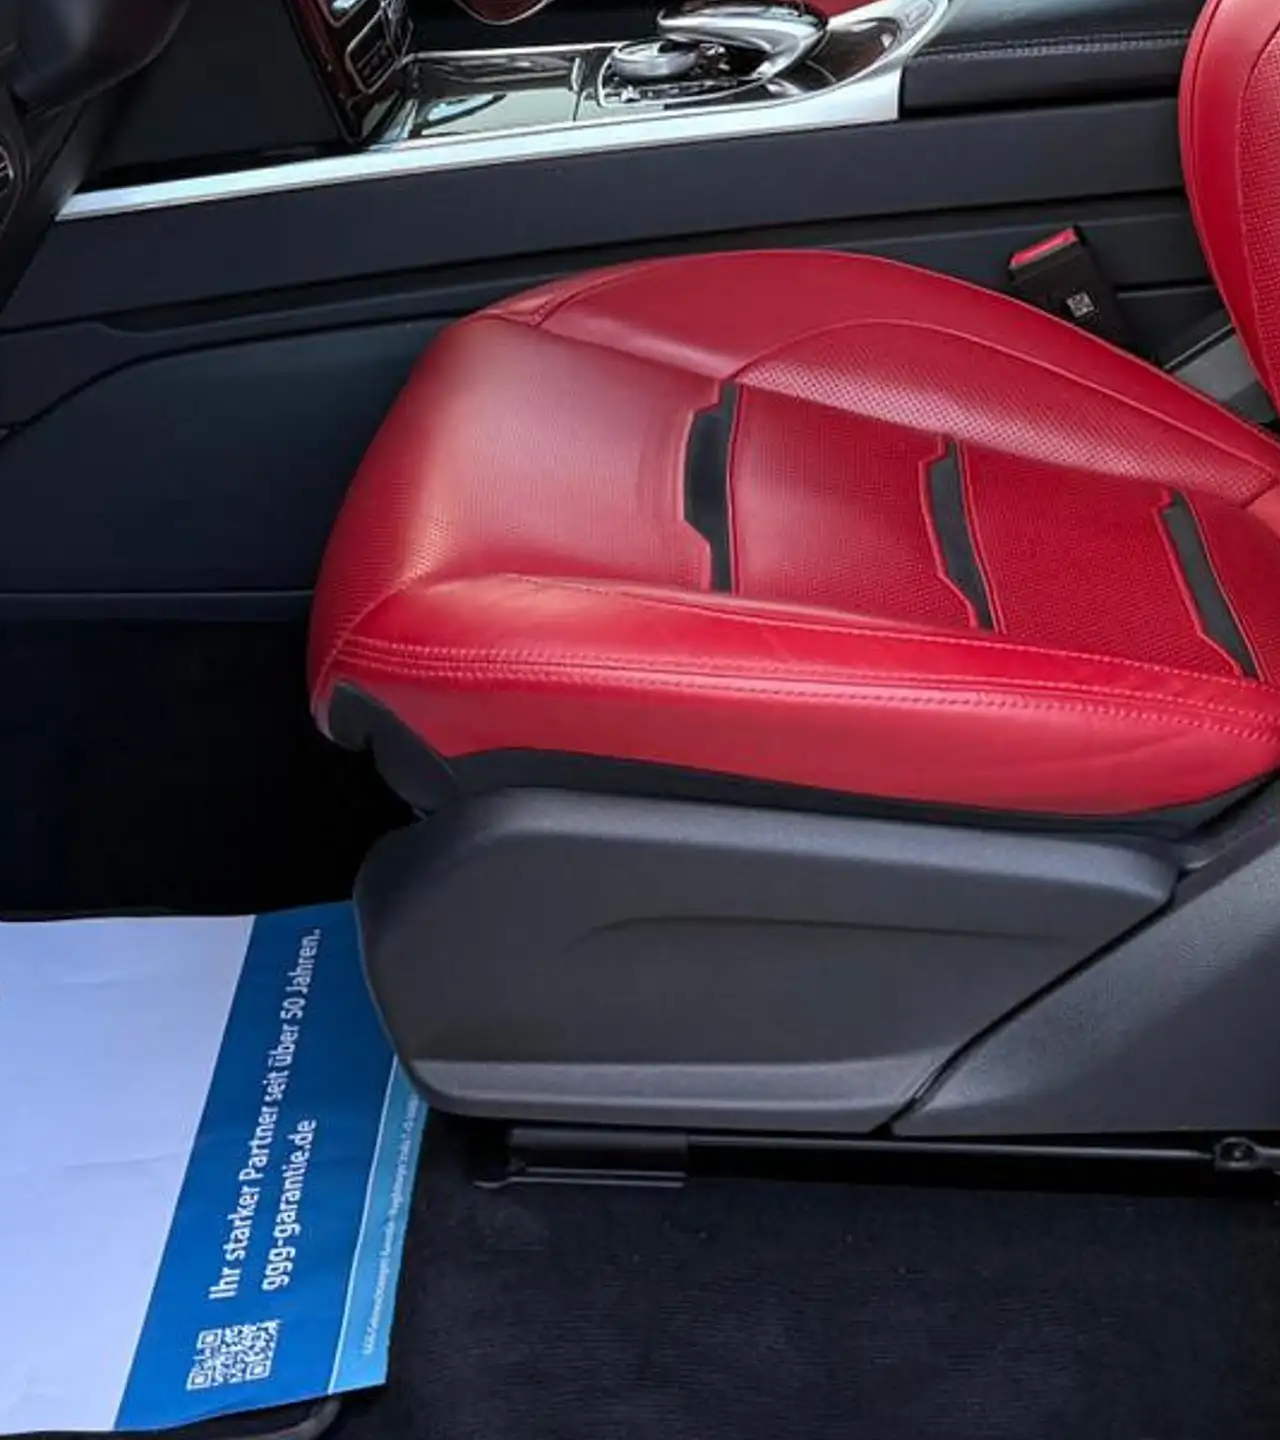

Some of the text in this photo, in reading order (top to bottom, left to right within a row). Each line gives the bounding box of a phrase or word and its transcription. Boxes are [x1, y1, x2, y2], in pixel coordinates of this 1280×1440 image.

[208, 928, 323, 1301] Ihr starker Partner seit über 50 Jahren.
[261, 1118, 318, 1292] ggg-garantie.de
